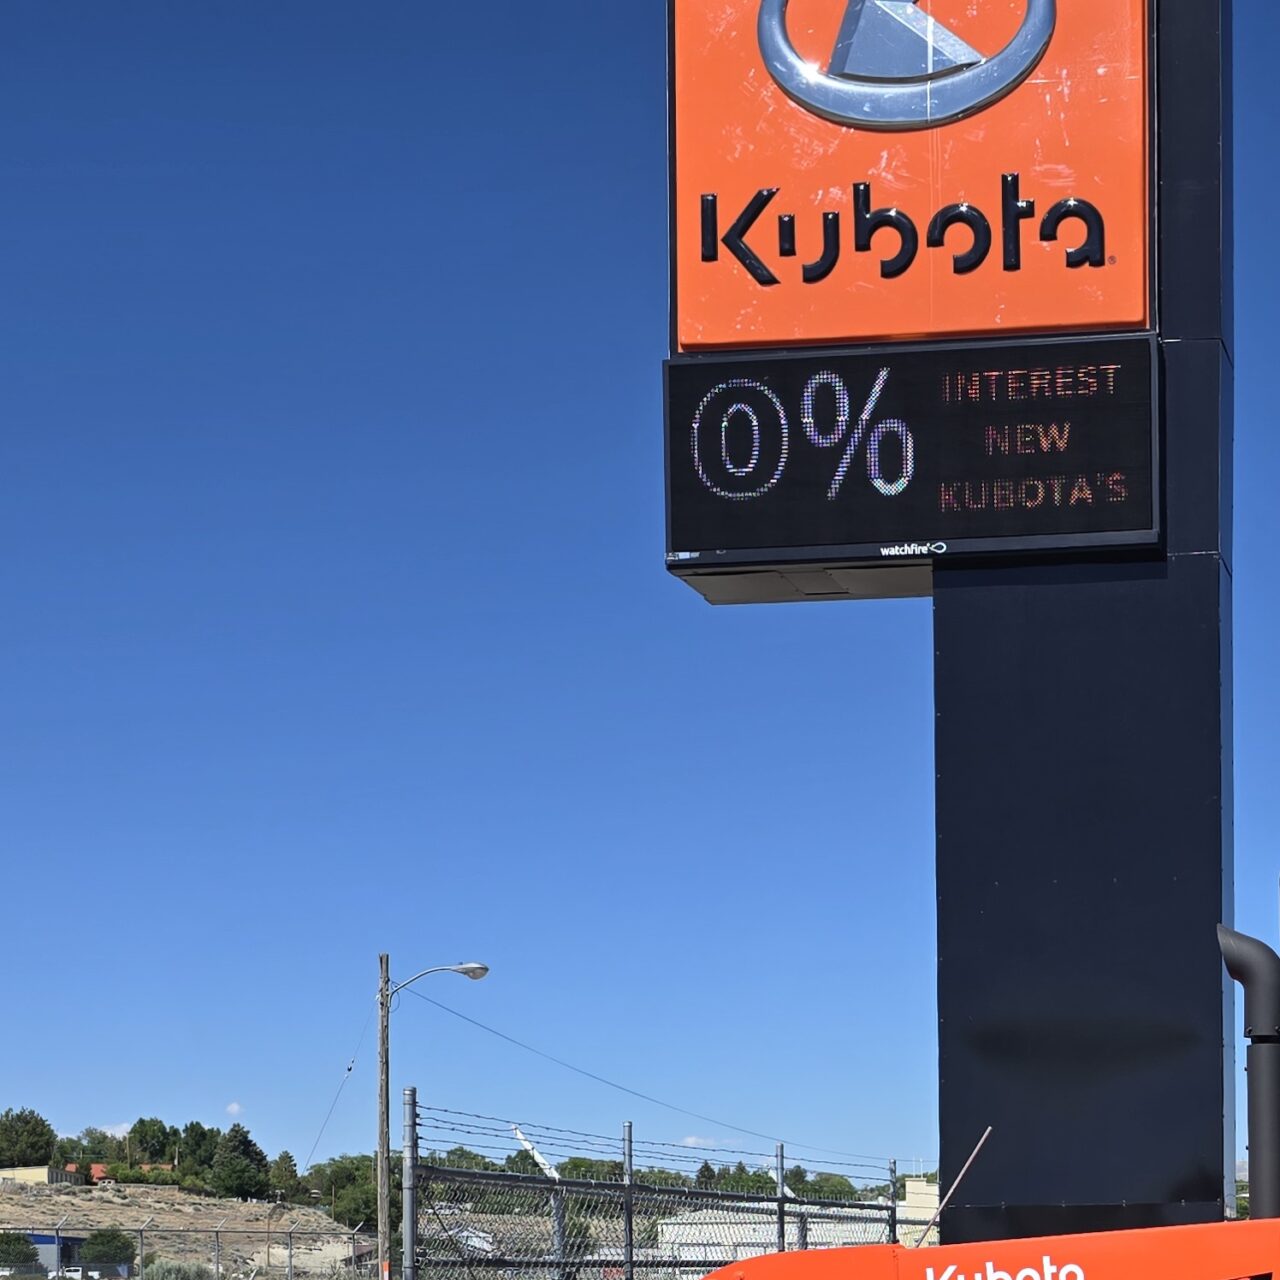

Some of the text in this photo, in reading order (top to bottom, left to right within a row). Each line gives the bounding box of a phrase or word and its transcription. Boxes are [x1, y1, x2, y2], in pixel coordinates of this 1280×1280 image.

[699, 172, 1107, 287] Kubota
[941, 364, 1122, 404] INTEREST
[984, 421, 1072, 456] NEW
[937, 471, 1129, 514] KUBOTA'S
[880, 542, 931, 557] watchfire
